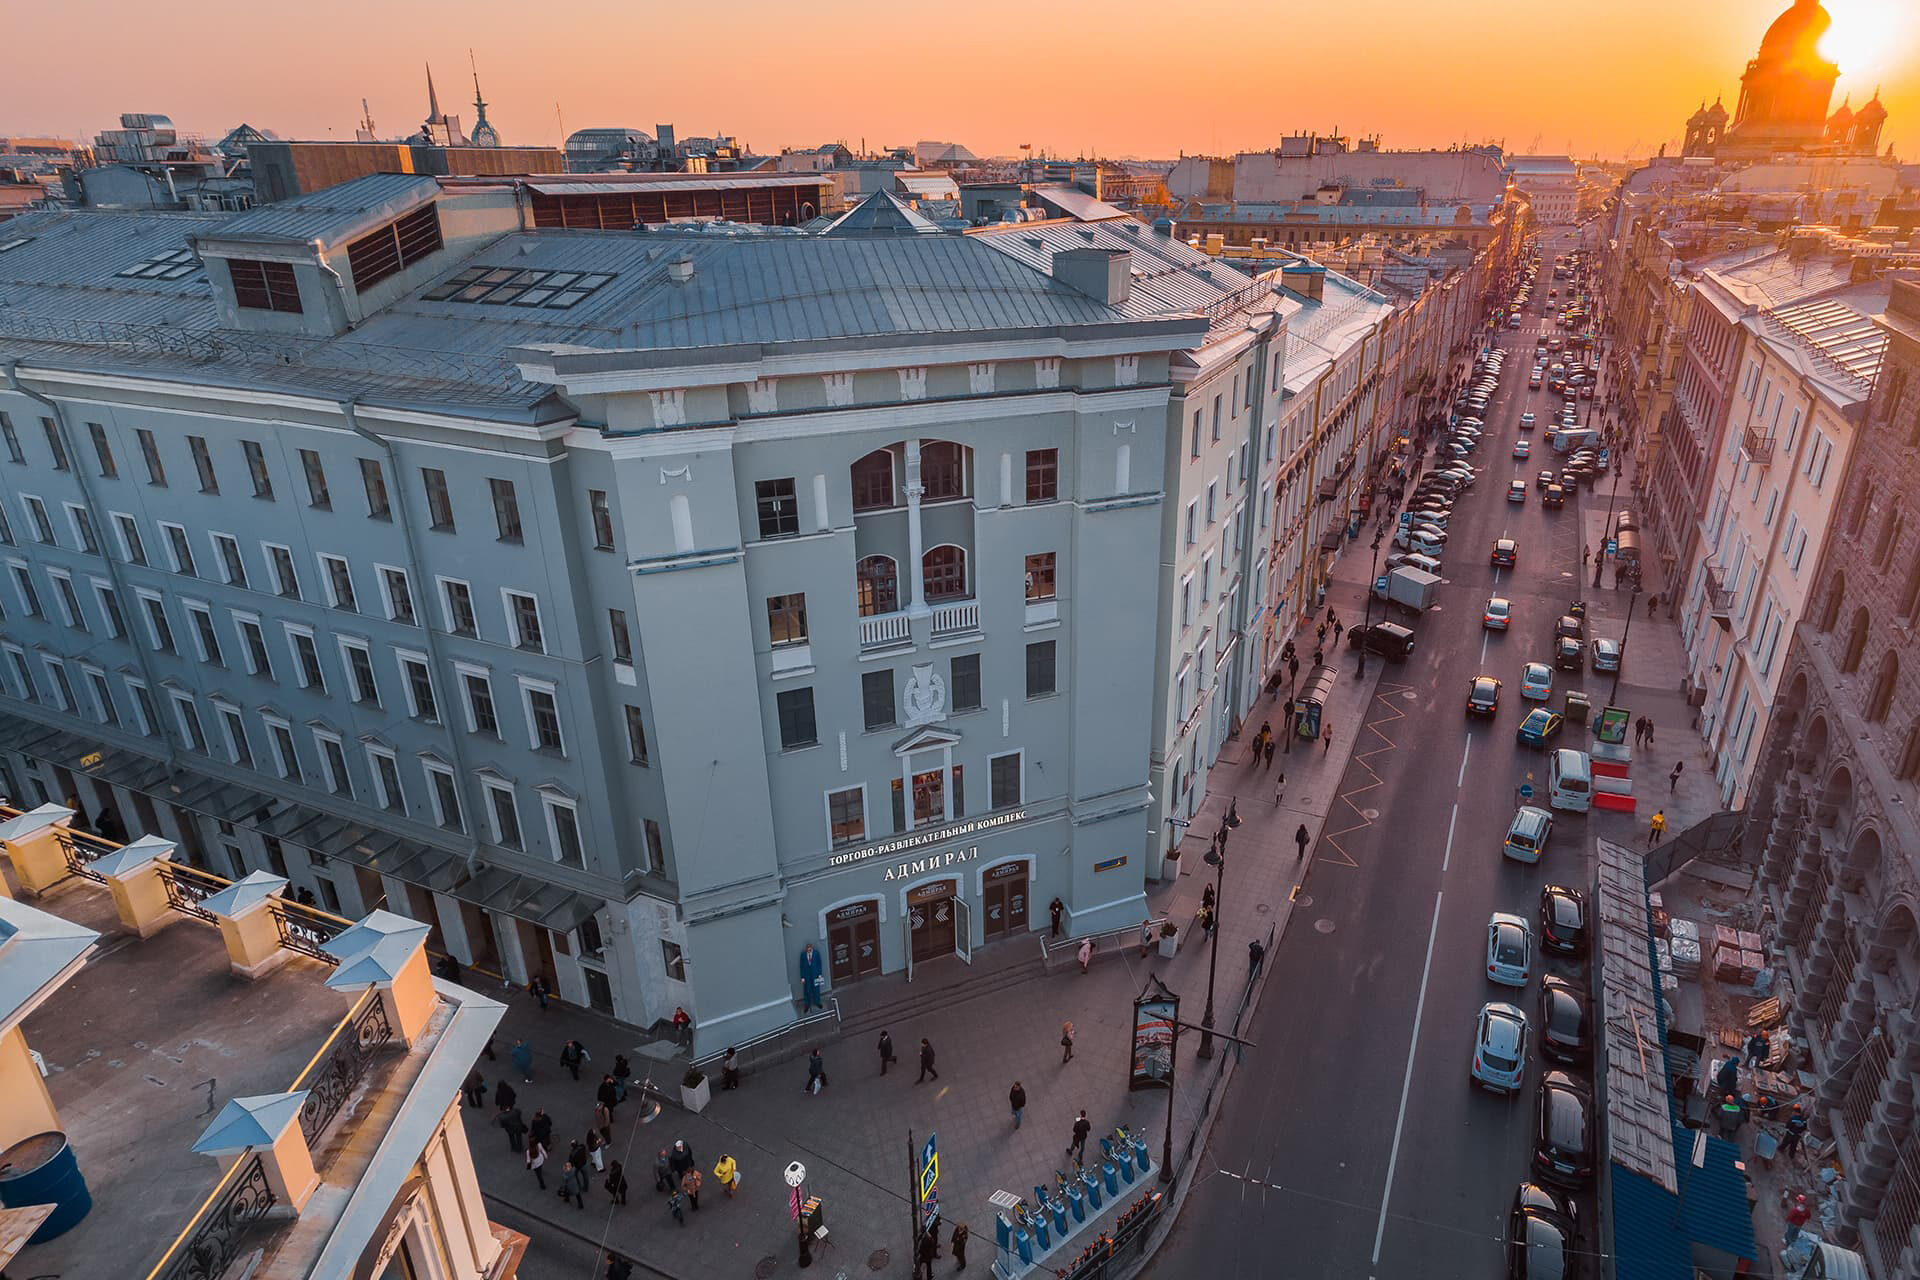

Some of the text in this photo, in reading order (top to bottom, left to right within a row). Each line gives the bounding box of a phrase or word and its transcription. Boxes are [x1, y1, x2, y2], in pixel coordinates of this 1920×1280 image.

[829, 811, 1027, 866] ТОРГОВО-РАЗВЛЕКАТЕЛЬНЫЙ КОМПЛЕКС
[883, 847, 979, 881] АДМИРАЛ
